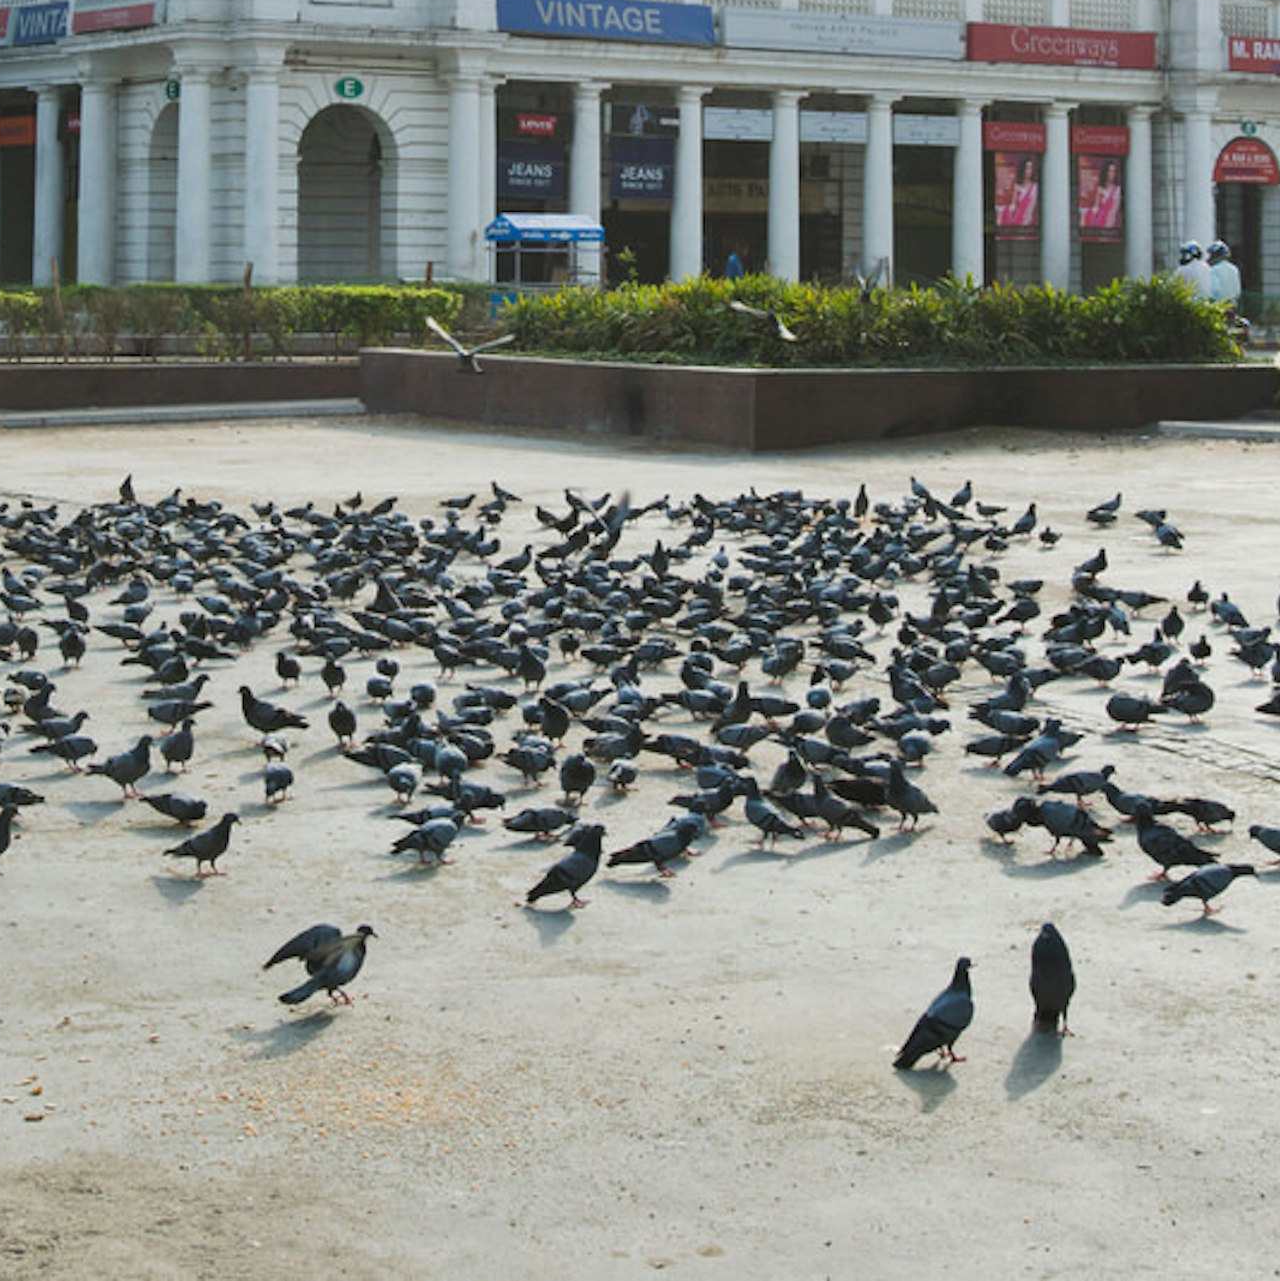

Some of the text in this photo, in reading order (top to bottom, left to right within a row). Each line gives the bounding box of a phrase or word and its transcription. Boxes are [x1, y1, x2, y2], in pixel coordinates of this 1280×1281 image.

[1011, 26, 1119, 62] Greenways
[1232, 40, 1250, 58] M.
[344, 80, 356, 97] E
[508, 162, 553, 178] JEANS
[620, 166, 664, 181] JEANS
